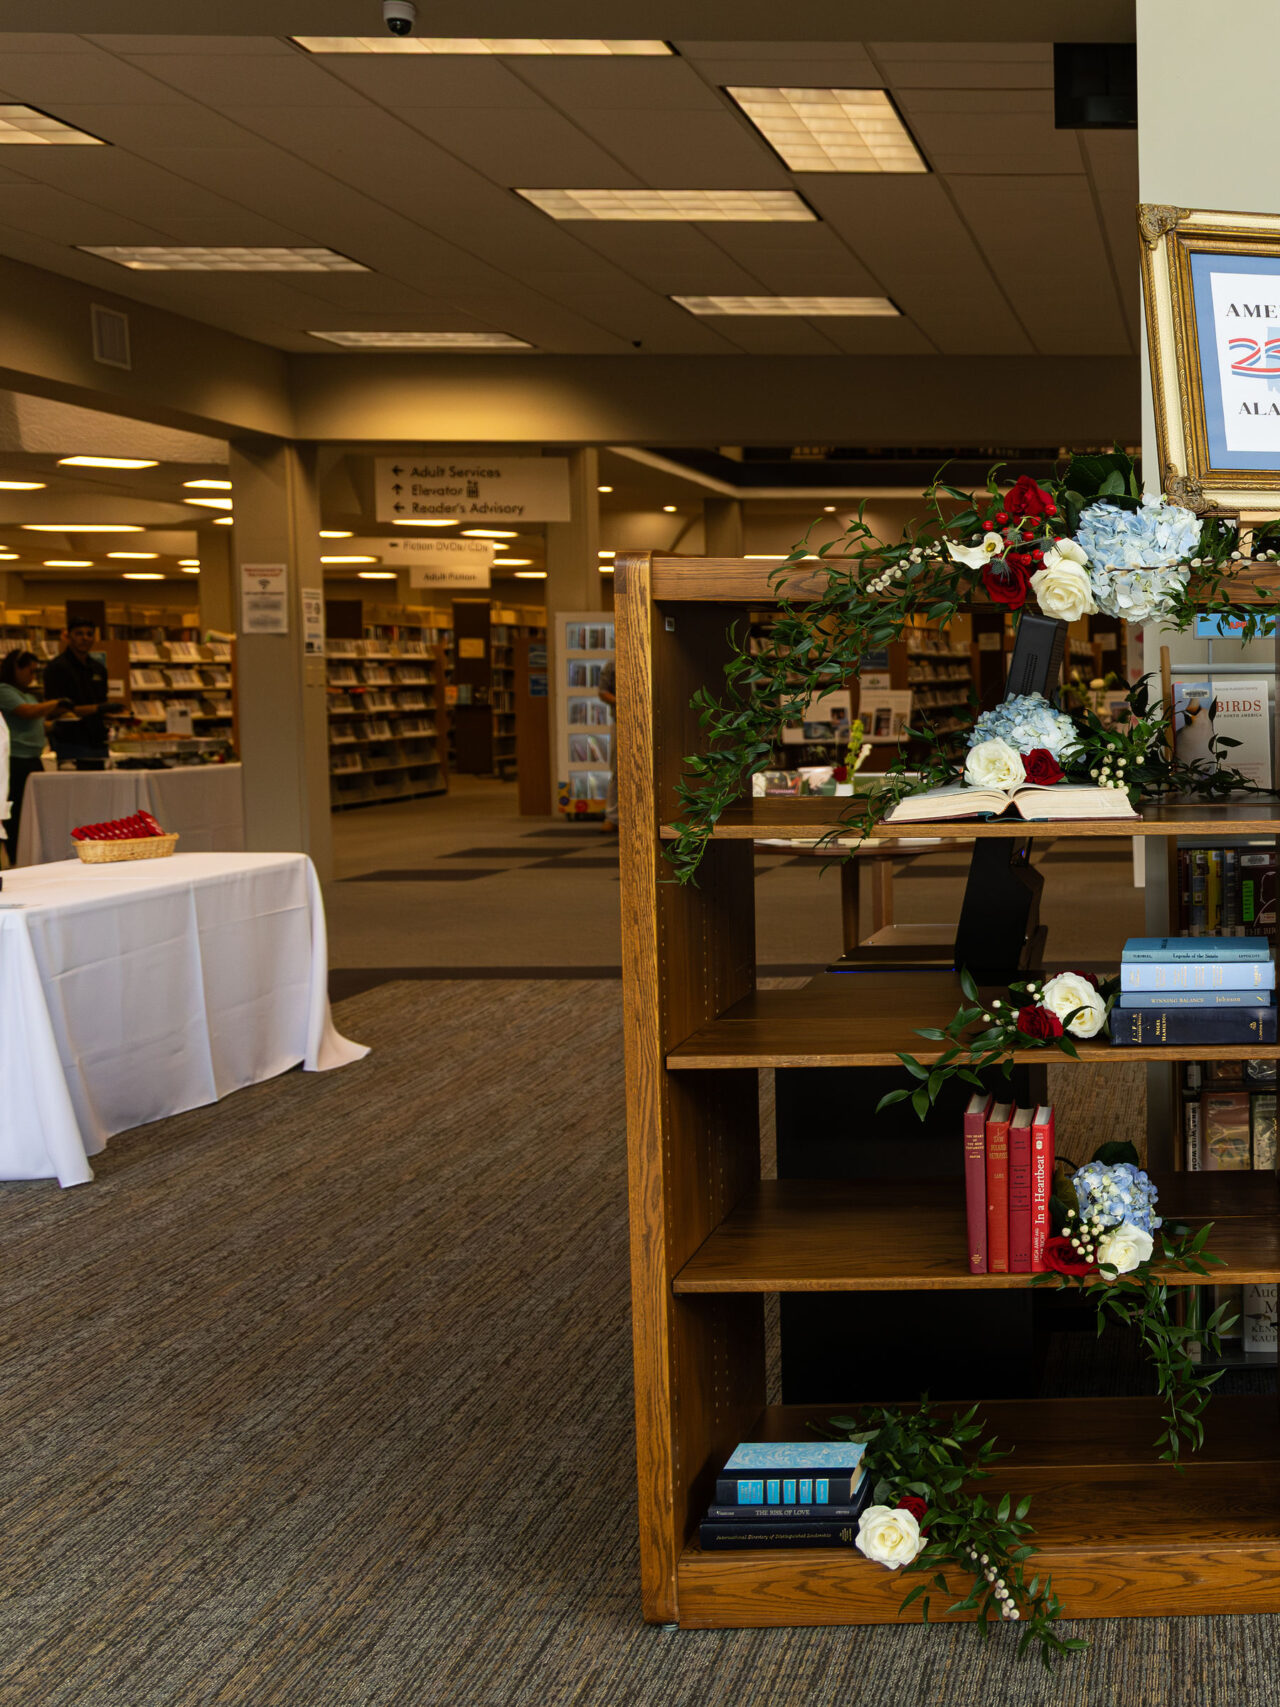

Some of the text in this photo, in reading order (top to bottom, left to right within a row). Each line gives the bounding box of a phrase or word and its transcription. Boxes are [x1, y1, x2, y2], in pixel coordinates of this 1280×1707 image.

[411, 465, 501, 478] Adult Services
[411, 484, 463, 496] Elevator
[412, 502, 525, 516] Reader's Advisory
[1216, 700, 1262, 712] BIRDS
[1034, 1155, 1045, 1202] Heartbeat
[1035, 1213, 1045, 1224] In
